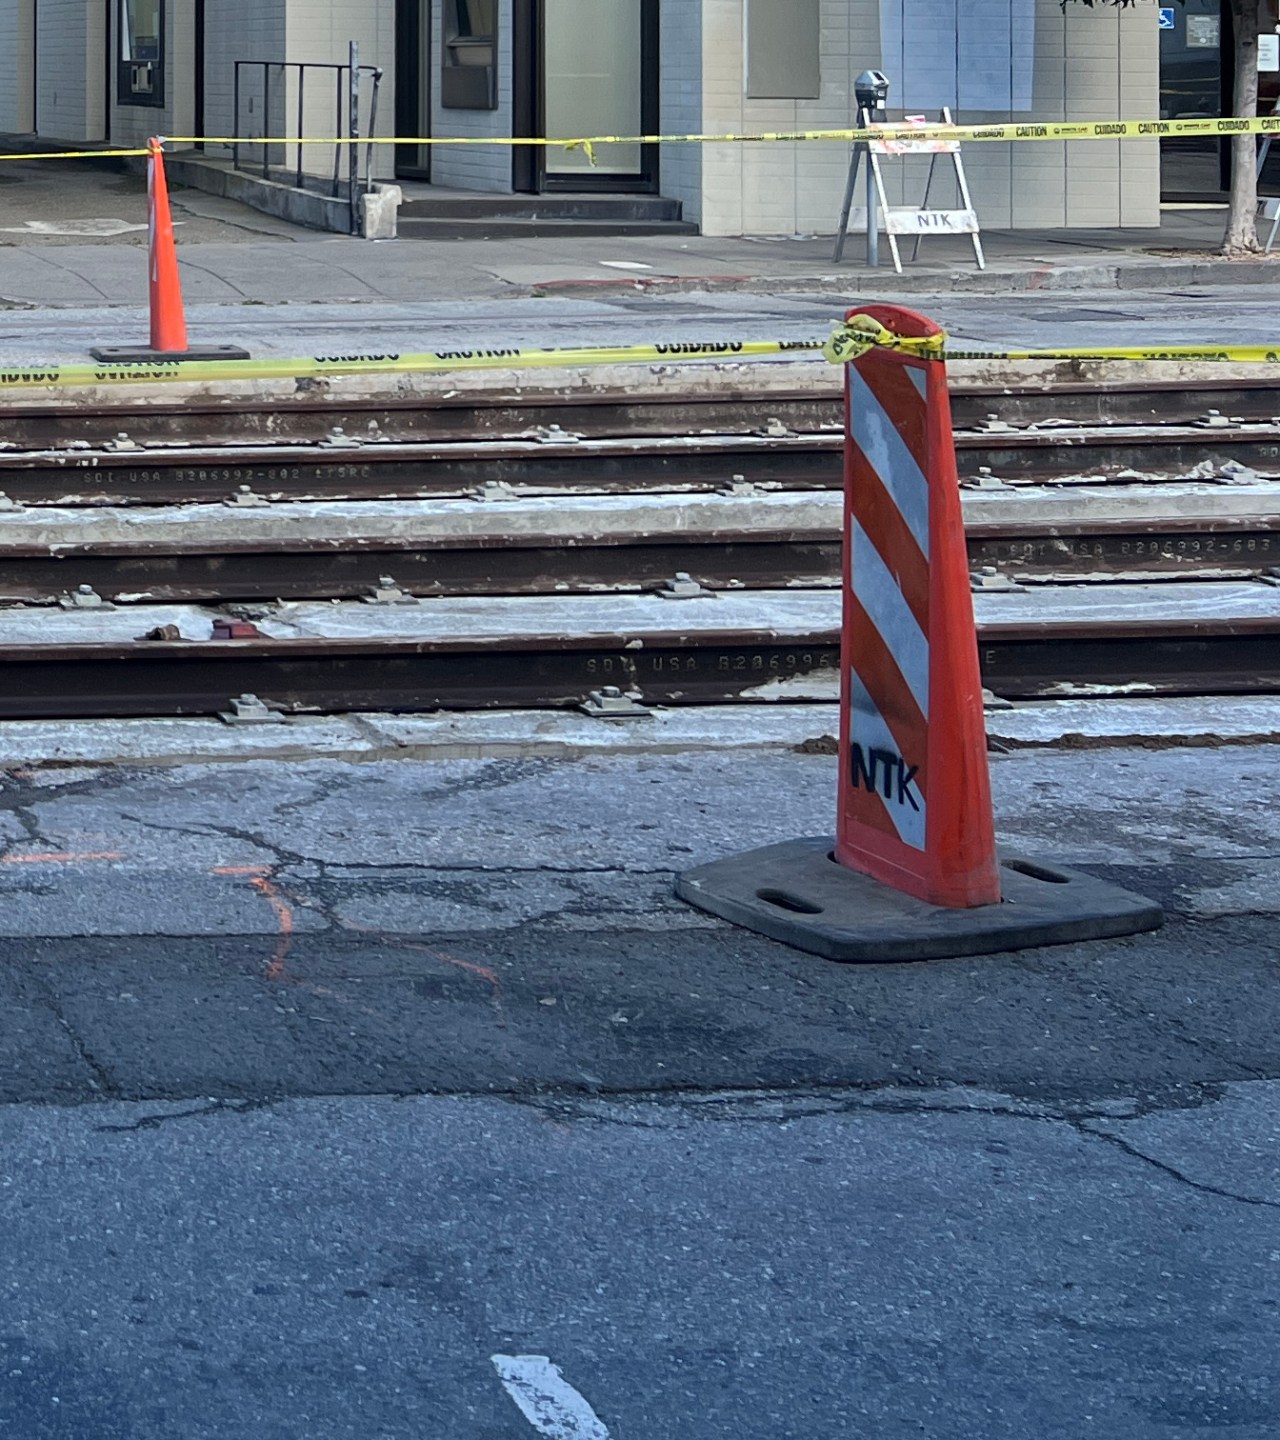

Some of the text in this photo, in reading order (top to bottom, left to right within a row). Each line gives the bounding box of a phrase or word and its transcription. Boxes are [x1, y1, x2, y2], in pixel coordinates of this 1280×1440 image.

[1015, 126, 1048, 137] CAUTION
[1094, 124, 1126, 135] CUIDADO
[1138, 123, 1170, 134] CAUTION
[1217, 120, 1250, 132] CUIDADO
[917, 213, 951, 228] NTK
[129, 471, 161, 482] USA
[652, 656, 697, 672] USA
[851, 742, 920, 812] NTK
